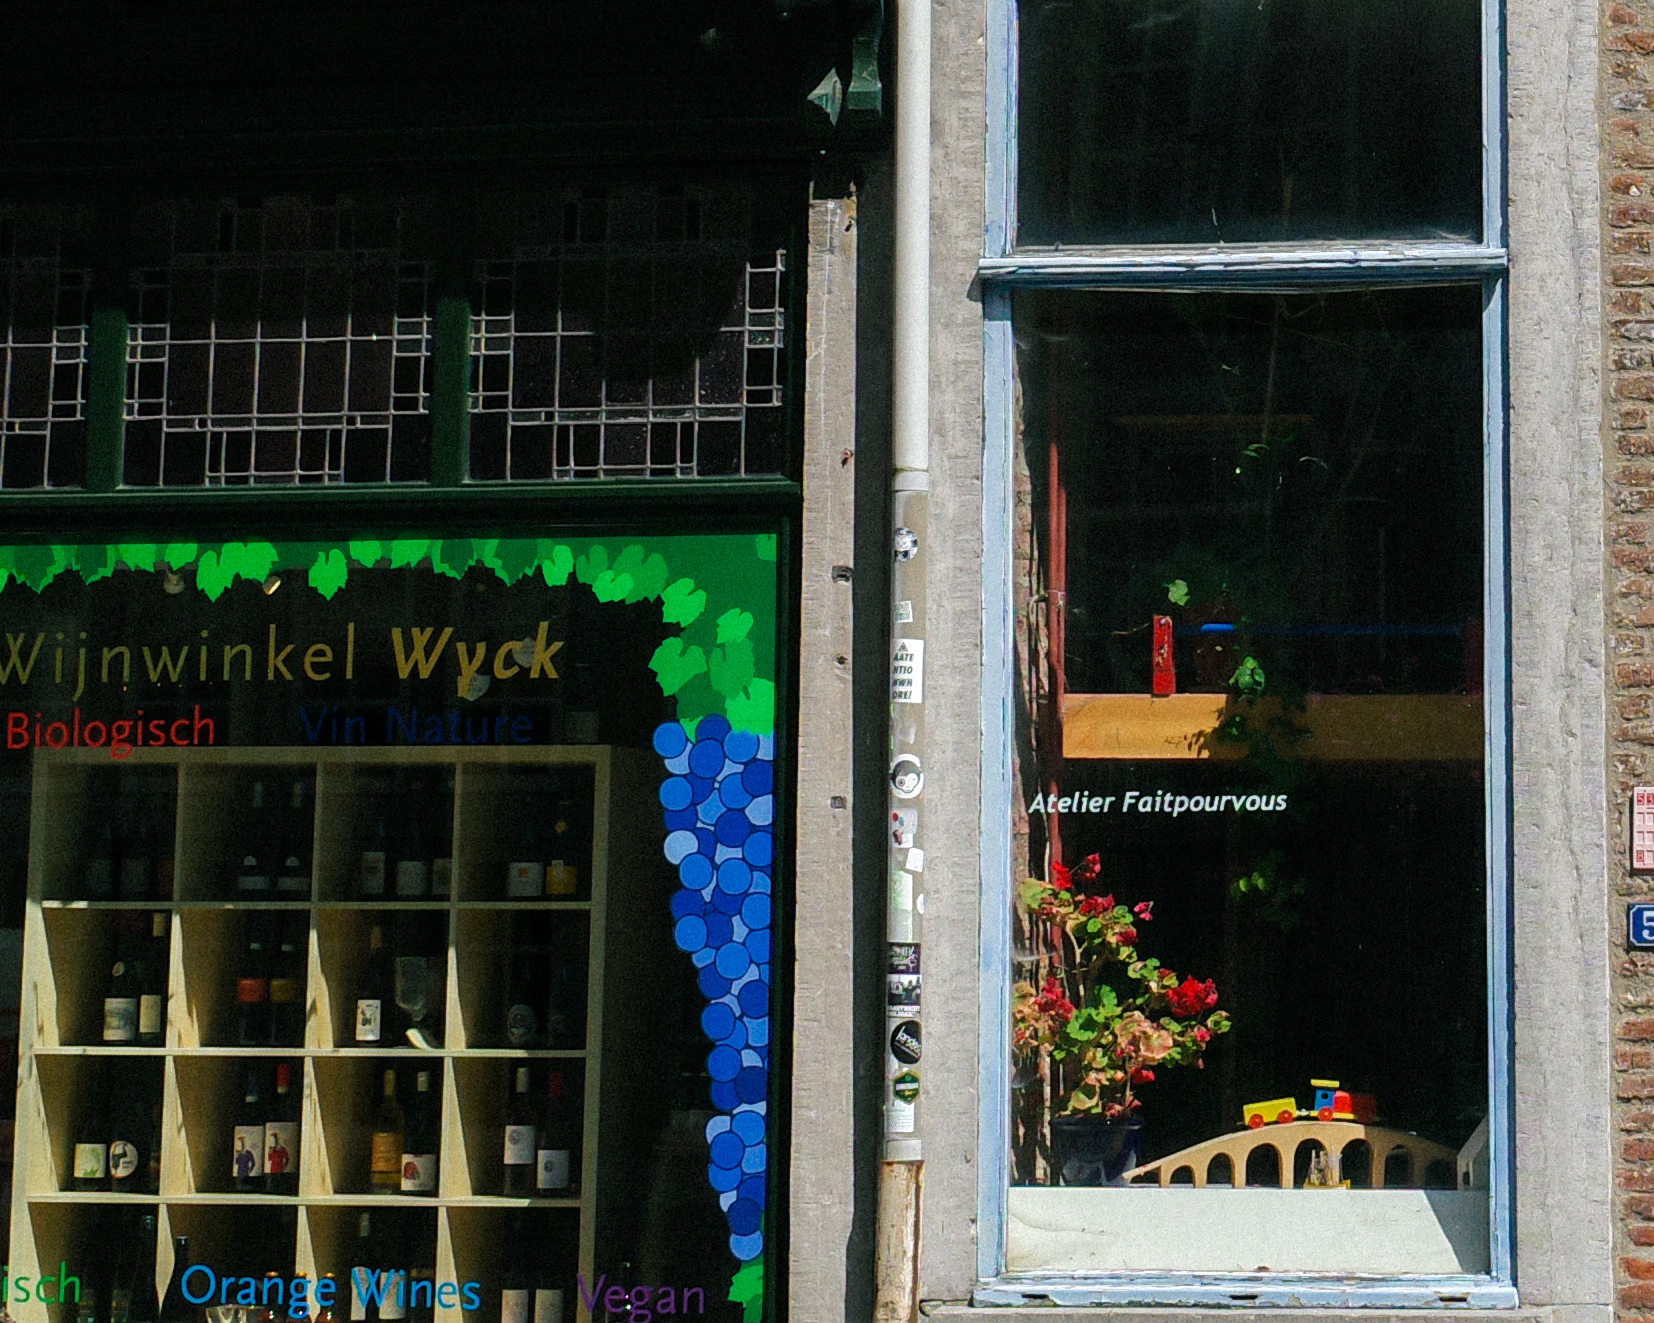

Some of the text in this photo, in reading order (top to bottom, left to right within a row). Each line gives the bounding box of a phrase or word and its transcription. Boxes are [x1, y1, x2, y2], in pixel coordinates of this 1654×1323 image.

[0, 620, 566, 702] Wijnwinkel Wyck
[6, 704, 215, 760] Biologisch
[299, 705, 534, 744] Vin Nature
[1028, 790, 1288, 817] Atelier Faitpourvous
[181, 1264, 482, 1319] Orange Wines
[577, 1273, 705, 1323] Vegan
